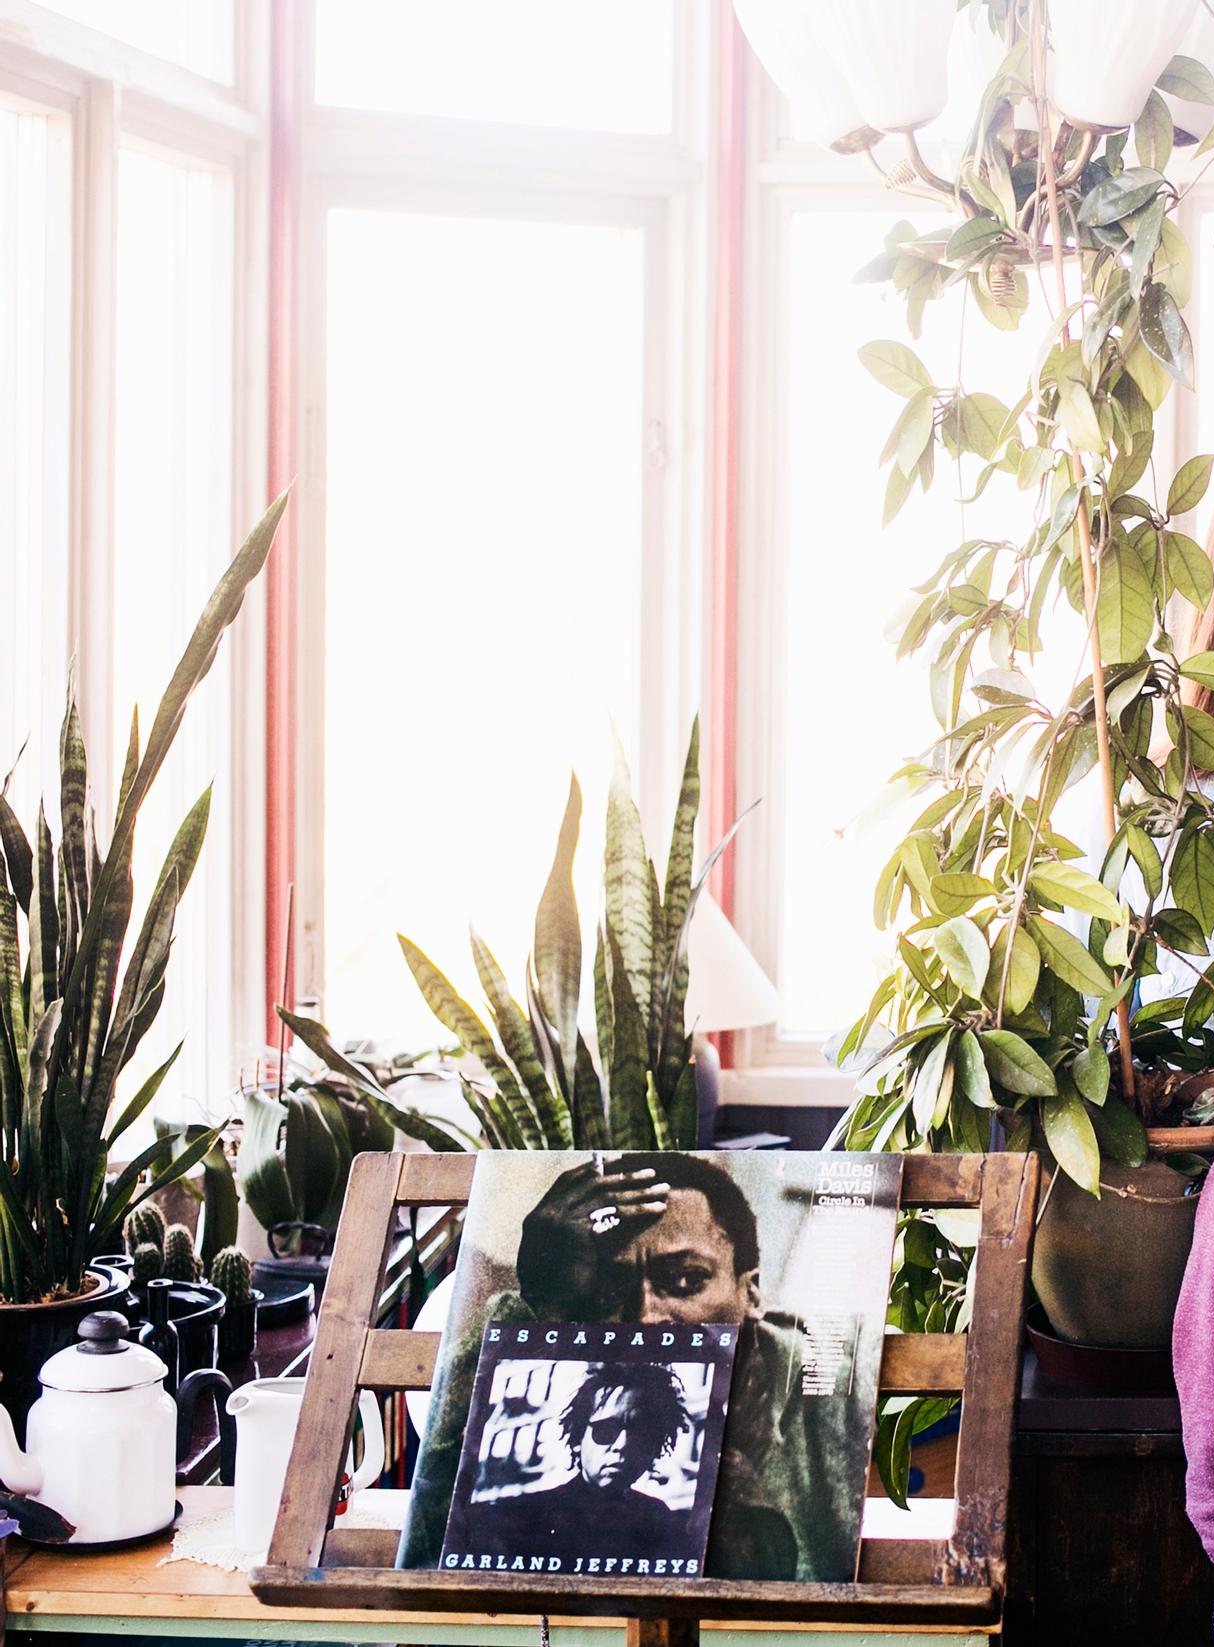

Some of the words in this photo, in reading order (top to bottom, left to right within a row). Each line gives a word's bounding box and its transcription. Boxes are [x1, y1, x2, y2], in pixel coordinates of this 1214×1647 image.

[817, 1161, 874, 1177] Miles
[815, 1178, 872, 1194] Davis
[818, 1196, 852, 1206] Circle
[852, 1196, 866, 1207] In
[488, 1328, 732, 1347] ESCAPADES
[445, 1553, 563, 1572] GARLAND
[573, 1556, 700, 1575] JEFFREYS
